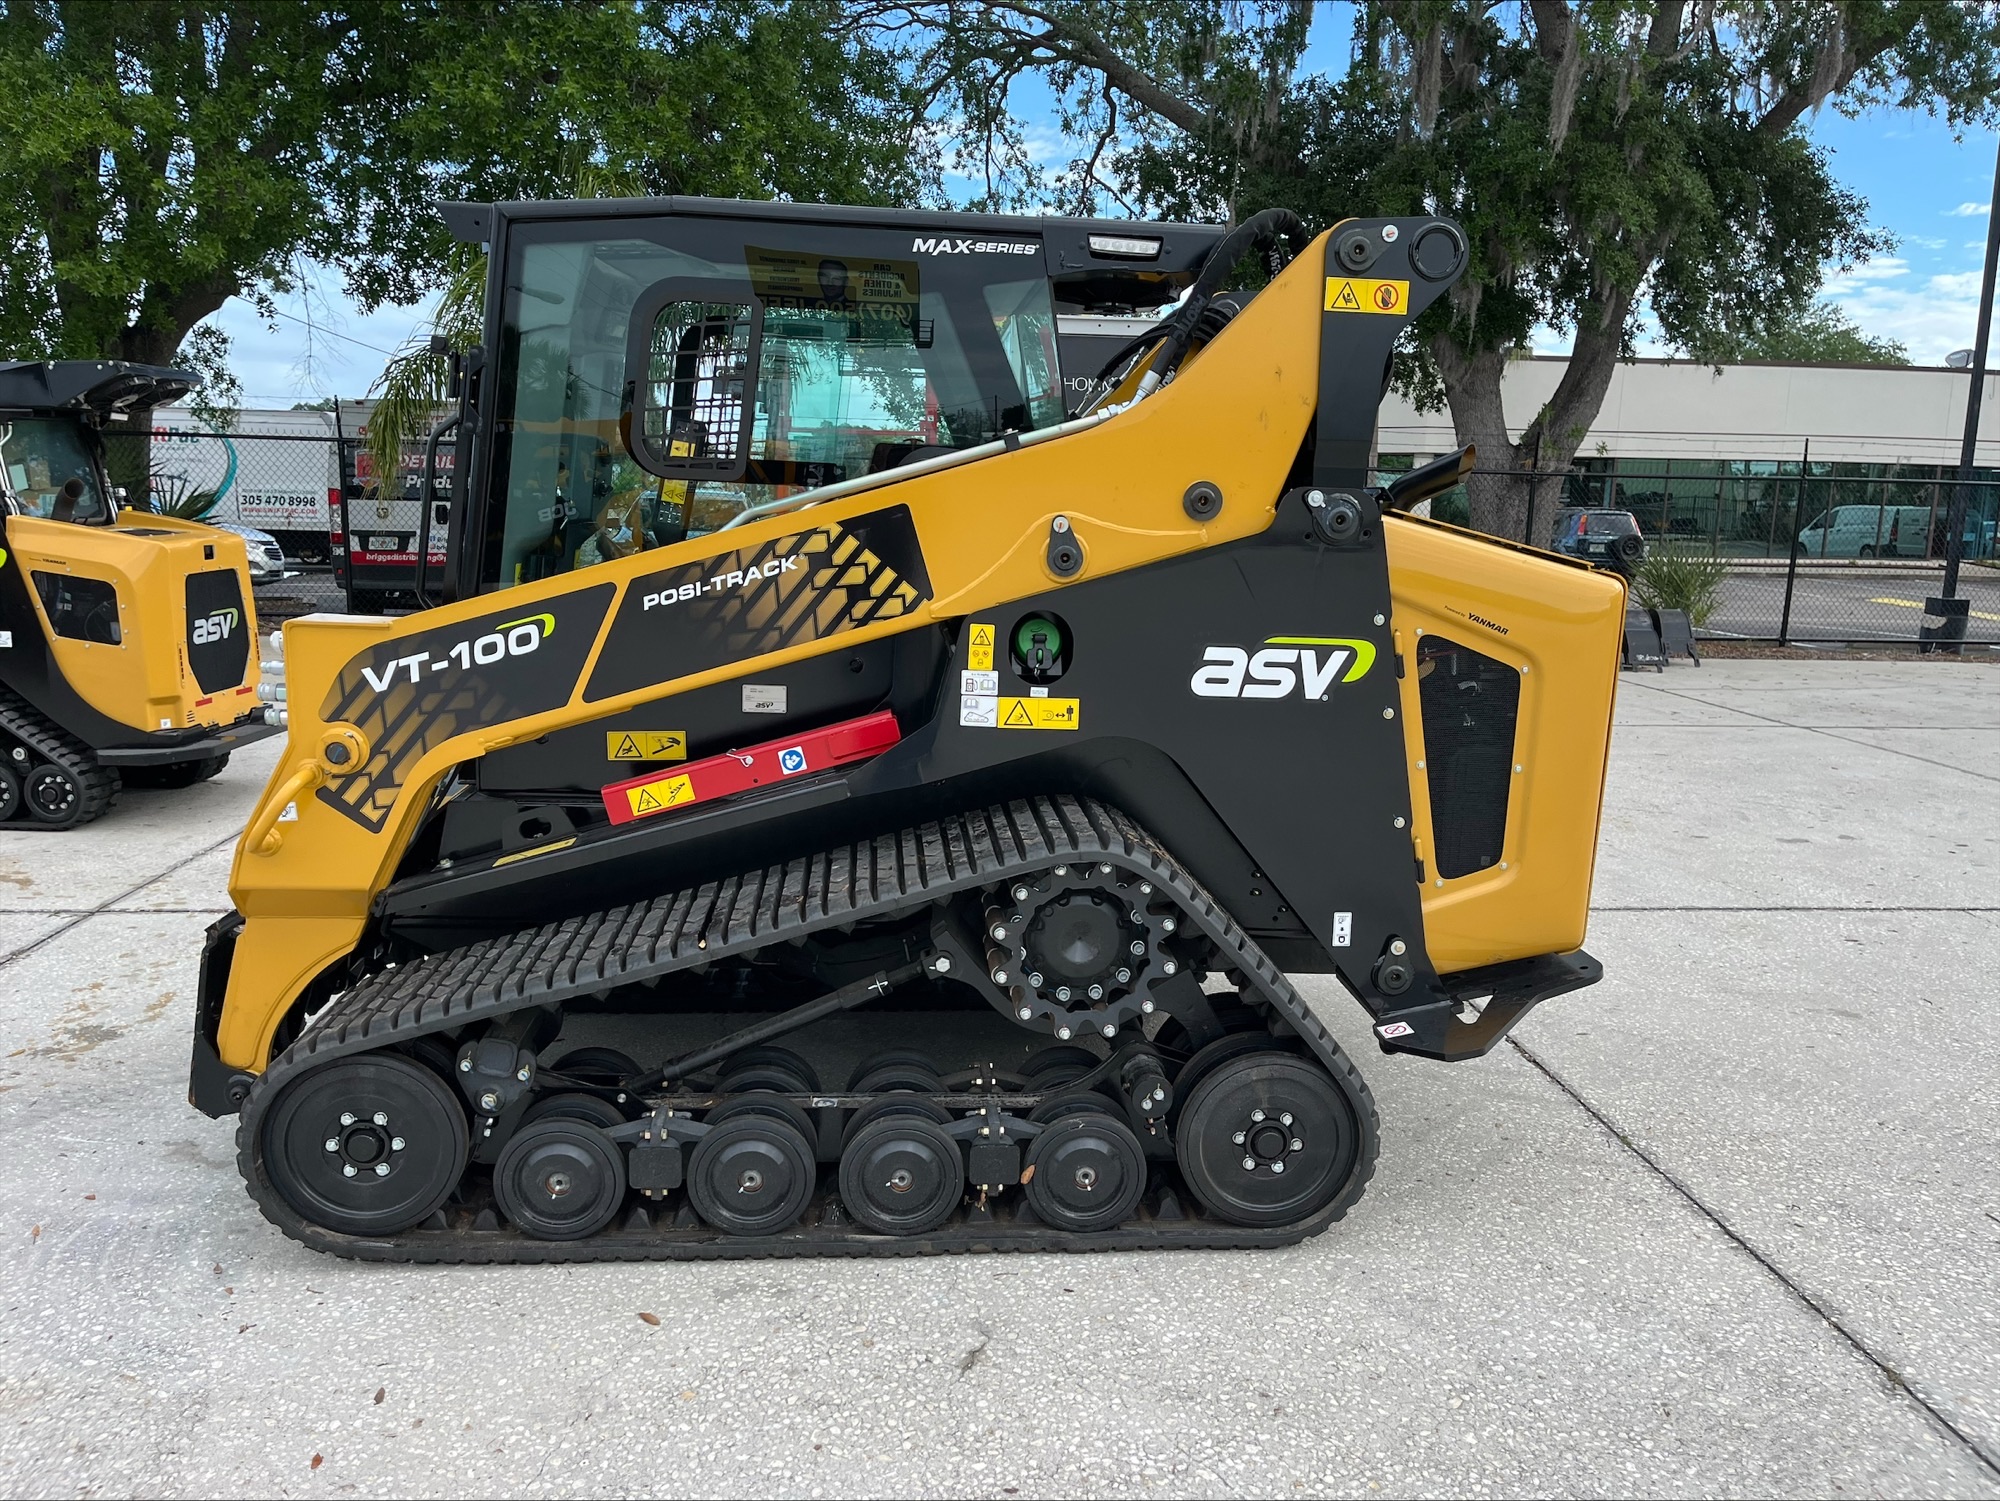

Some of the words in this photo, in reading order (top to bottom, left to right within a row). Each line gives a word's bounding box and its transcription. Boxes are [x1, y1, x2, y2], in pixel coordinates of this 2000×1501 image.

[912, 238, 1036, 256] MAX-SERIES
[241, 495, 262, 505] 305
[265, 495, 286, 506] 470
[288, 496, 316, 507] 8998
[643, 555, 798, 611] POSI-TRACK
[1467, 612, 1509, 635] YANMAR
[361, 624, 540, 693] VT-100
